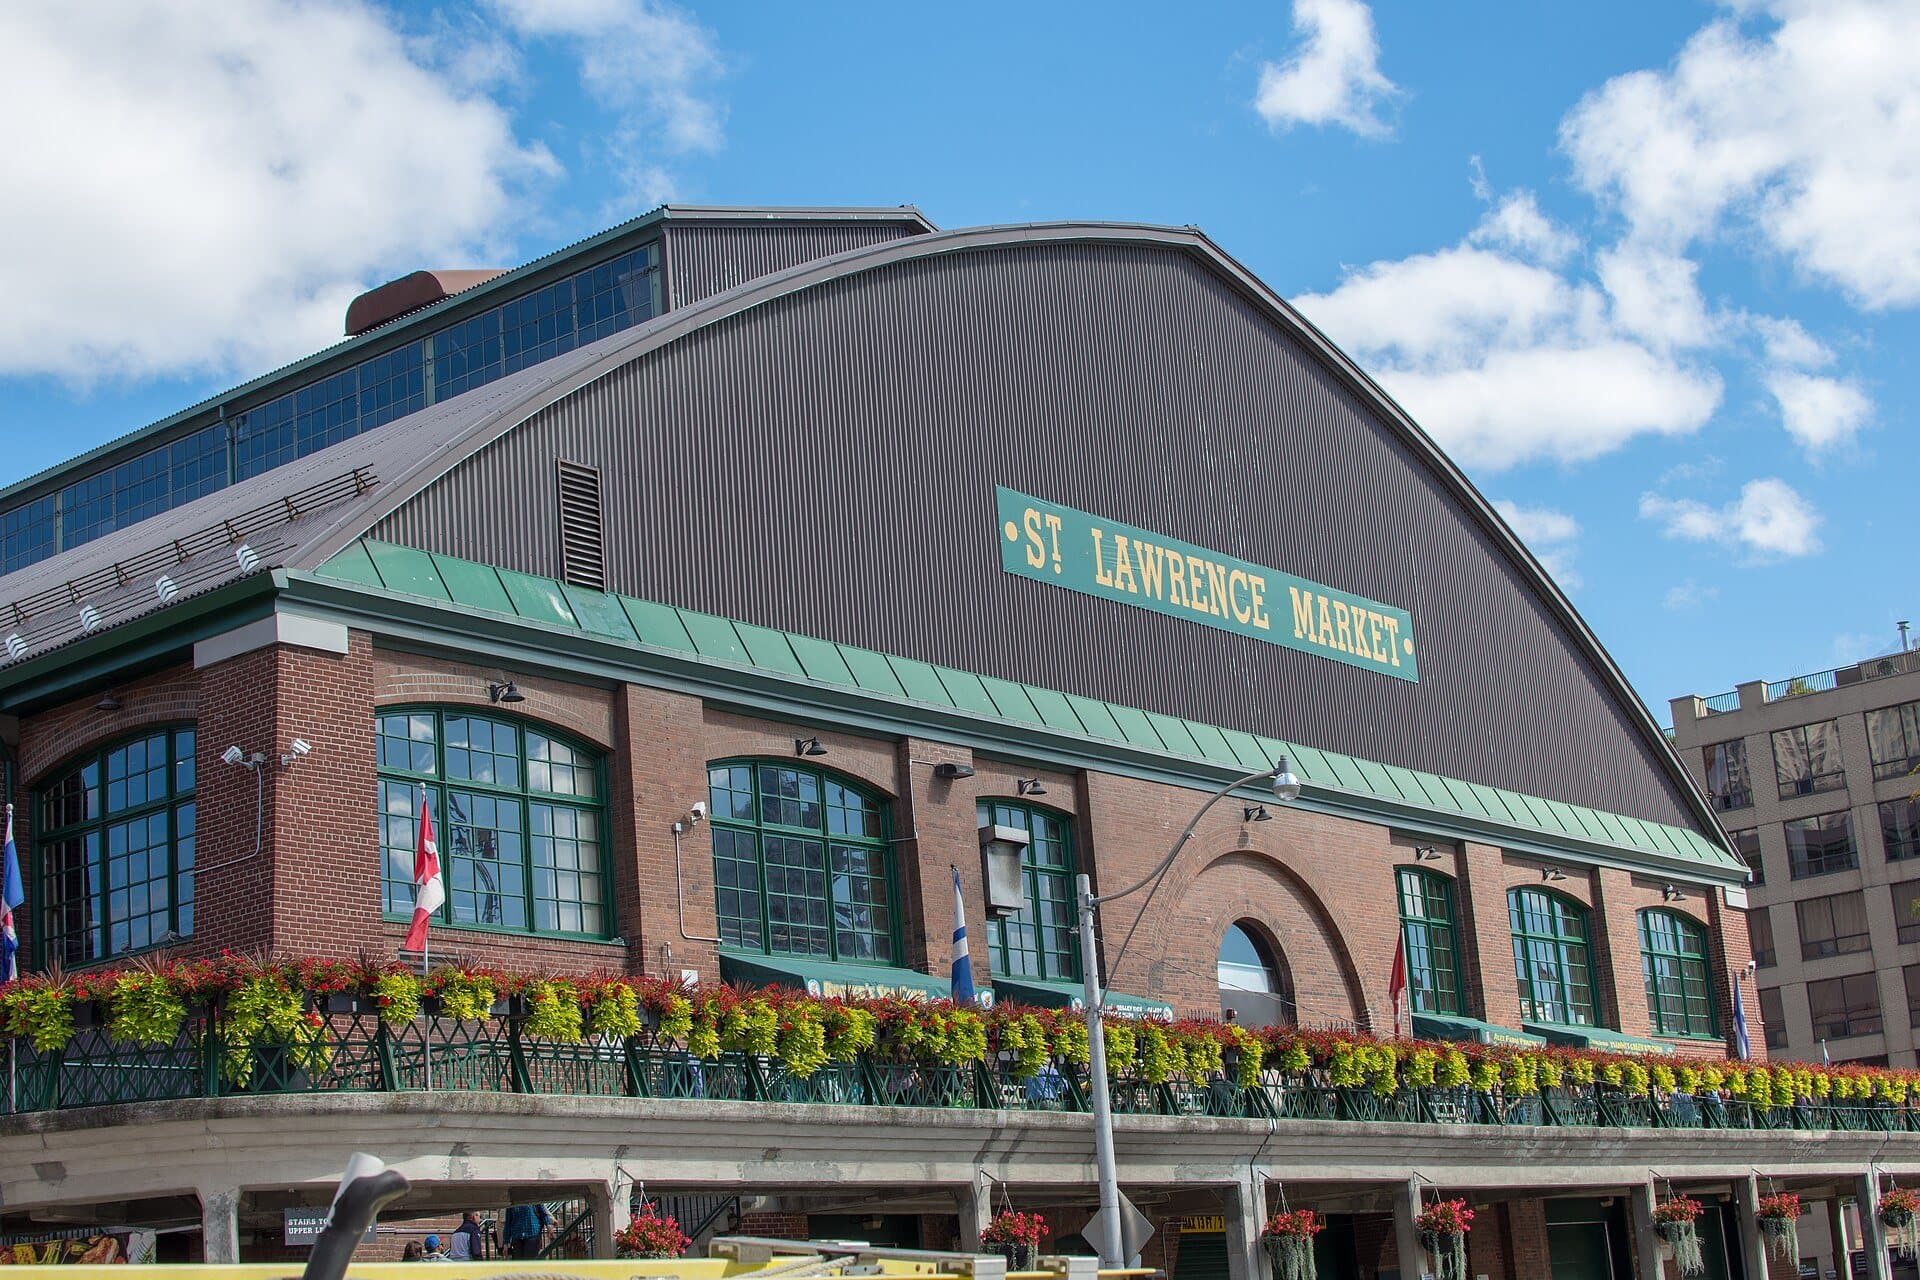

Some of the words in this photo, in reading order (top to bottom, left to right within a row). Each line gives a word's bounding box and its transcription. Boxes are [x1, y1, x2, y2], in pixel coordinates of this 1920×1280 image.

[1091, 527, 1269, 630] LAWRENCE
[1289, 586, 1401, 667] MARKET
[288, 1218, 316, 1226] STAIRS
[288, 1227, 313, 1235] UPPER
